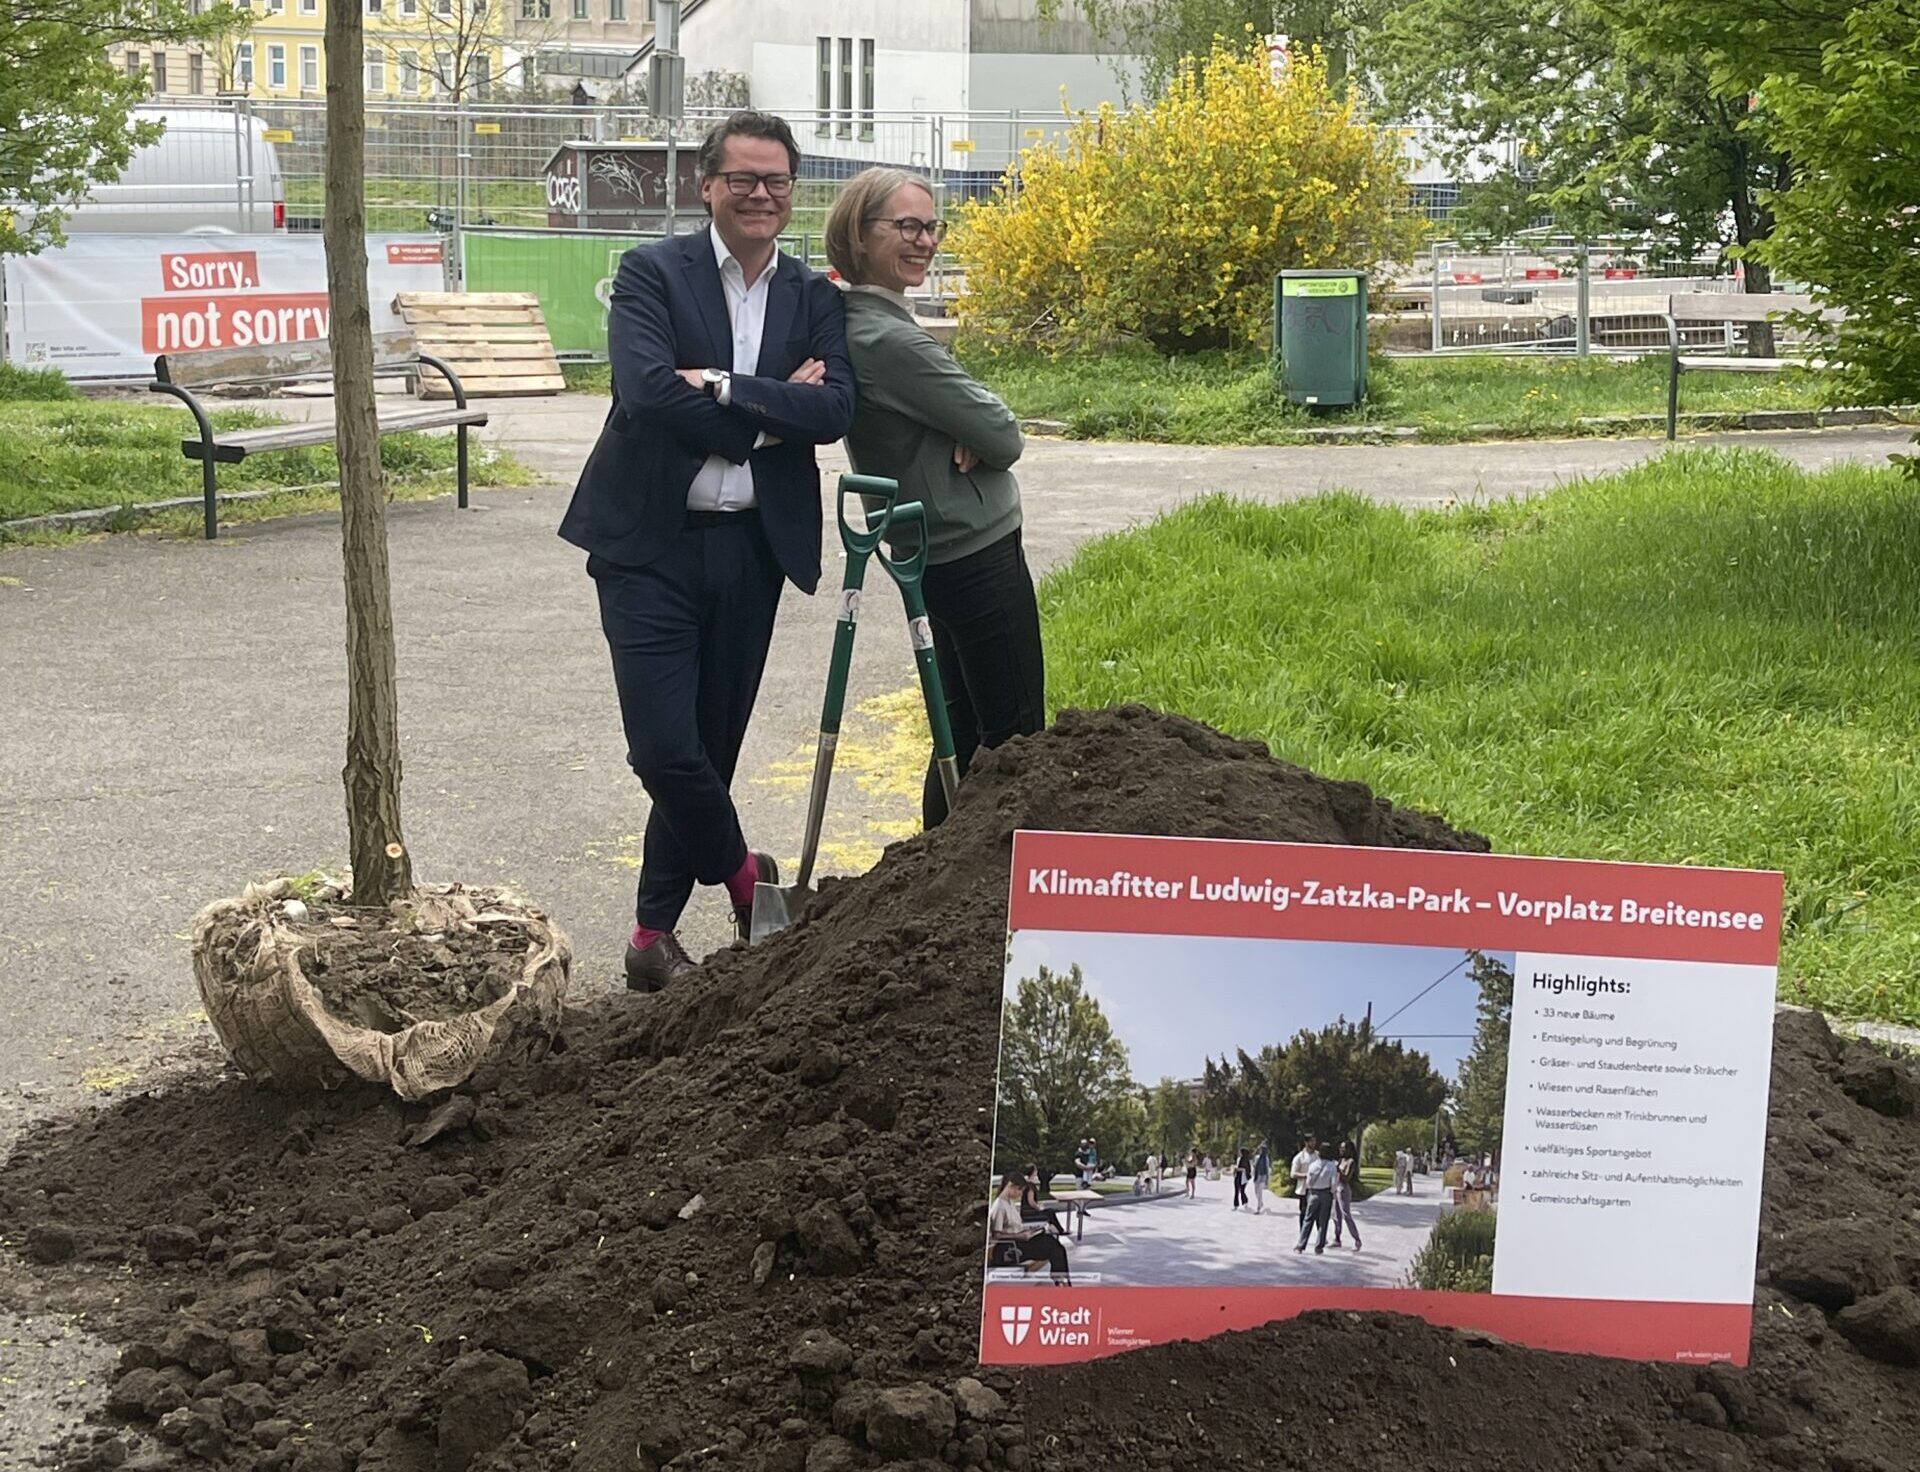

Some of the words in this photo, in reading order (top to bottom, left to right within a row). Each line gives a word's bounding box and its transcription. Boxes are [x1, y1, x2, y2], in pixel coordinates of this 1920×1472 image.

[170, 256, 252, 292] Sorry,
[157, 301, 222, 350] not
[1028, 868, 1183, 899] Klimafitter
[1190, 875, 1470, 913] Ludwig-Zatzka-Park
[1497, 891, 1613, 926] Vorplatz
[1620, 899, 1764, 930] Breitensee
[1533, 973, 1631, 996] Highlights:
[1543, 1008, 1555, 1018] 33
[1557, 1010, 1580, 1019] neue
[1582, 1010, 1615, 1021] Bäume
[1541, 1032, 1603, 1047] Entsiegelung
[1605, 1037, 1624, 1046] und
[1626, 1037, 1678, 1051] Begrünung
[1539, 1057, 1575, 1069] Gräser-
[1577, 1060, 1595, 1070] und
[1598, 1061, 1663, 1074] Staudenbeete
[1665, 1065, 1692, 1075] sowie
[1694, 1065, 1738, 1077] Sträucher
[1538, 1082, 1573, 1094] Wiesen
[1575, 1085, 1594, 1095] und
[1596, 1085, 1658, 1098] Rasenflächen
[1536, 1107, 1604, 1119] Wasserbecken
[1607, 1110, 1622, 1120] mit
[1624, 1110, 1687, 1123] Trinkbrunnen
[1689, 1114, 1707, 1124] und
[1535, 1119, 1598, 1132] Wasserdüsen
[1533, 1145, 1584, 1157] vielfältiges
[1586, 1146, 1651, 1160] Sportangebot
[1531, 1169, 1579, 1180] zahlreiche
[1582, 1171, 1602, 1182] Sitz-
[1604, 1172, 1623, 1182] und
[1625, 1173, 1743, 1188] Aufenthaltsmöglichkeiten
[1530, 1193, 1631, 1208] Gemeinschaftsgarten
[1040, 1306, 1092, 1325] Stadt
[1039, 1328, 1089, 1345] Wien
[1107, 1327, 1134, 1336] Wiener
